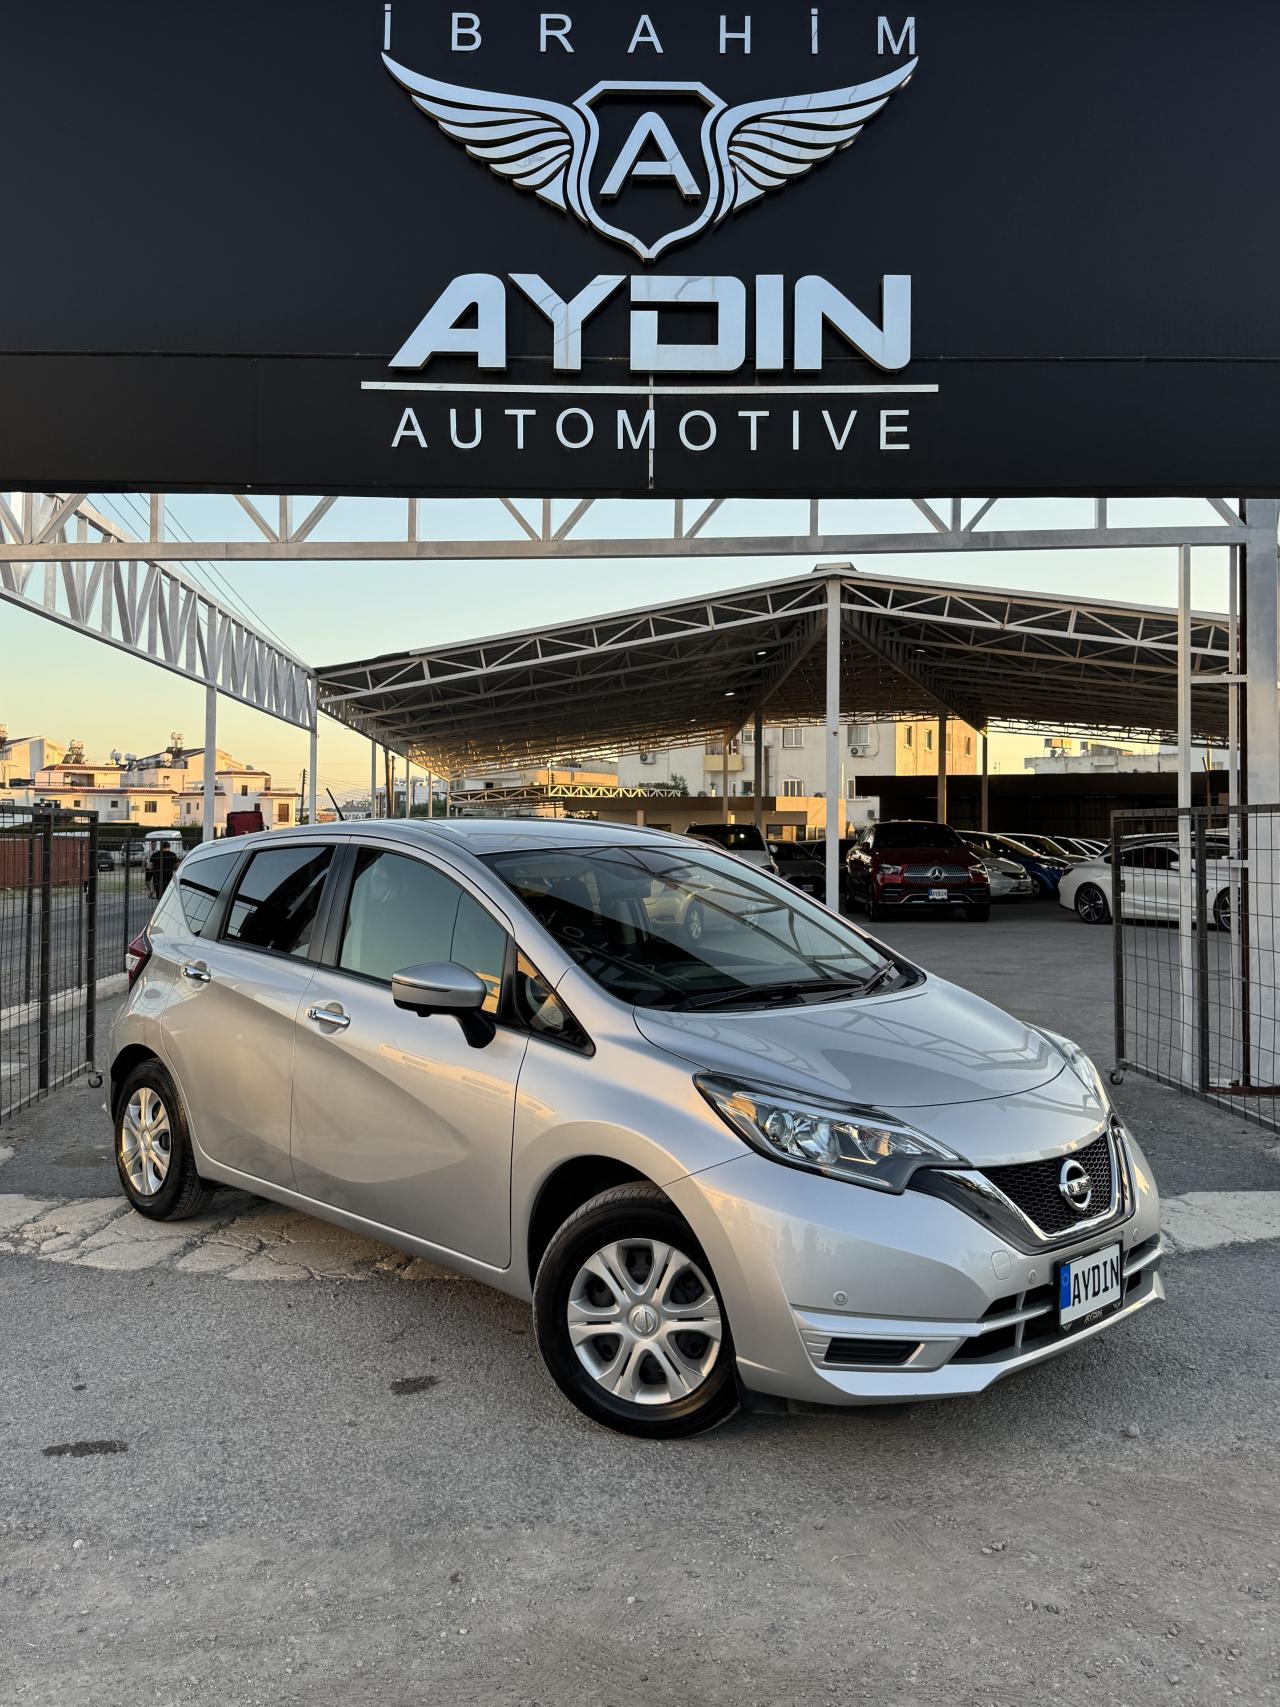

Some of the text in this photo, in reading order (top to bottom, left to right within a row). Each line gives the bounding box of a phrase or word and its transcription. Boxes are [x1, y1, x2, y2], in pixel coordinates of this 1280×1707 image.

[381, 4, 917, 55] İBRAHİM
[598, 111, 702, 199] A
[388, 273, 912, 373] AYDIN
[391, 407, 911, 451] AUTOMOTIVE
[1072, 1255, 1119, 1307] AYDIN
